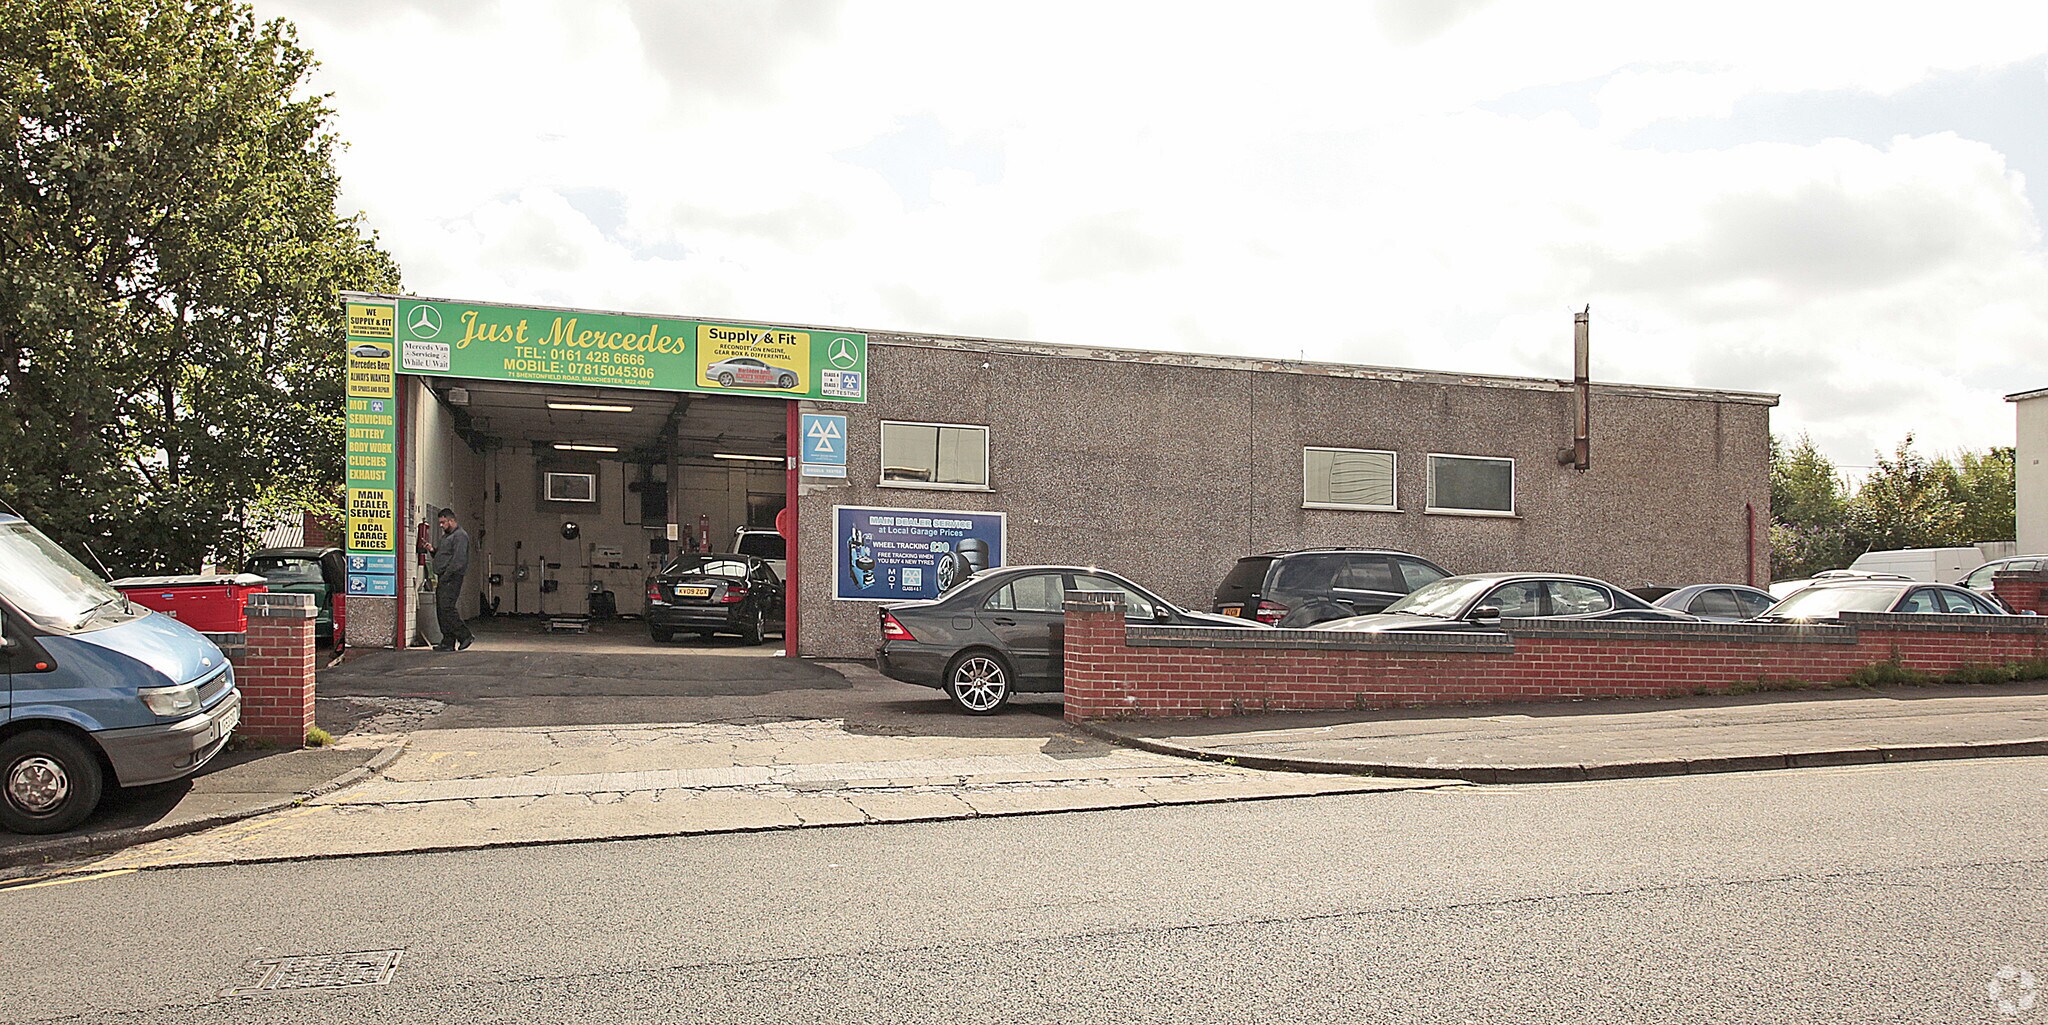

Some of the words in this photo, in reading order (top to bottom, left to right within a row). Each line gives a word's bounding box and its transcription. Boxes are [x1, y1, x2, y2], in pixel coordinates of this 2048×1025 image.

[366, 308, 376, 316] WE
[350, 316, 374, 326] SUPPLY
[382, 318, 392, 327] FIT
[456, 310, 529, 350] Just
[538, 316, 686, 355] Mercedes
[709, 328, 758, 344] Supply
[764, 333, 774, 344] &
[778, 334, 797, 345] Fit
[514, 346, 546, 360] TEL:
[550, 348, 581, 361] 0161
[586, 351, 610, 363] 428
[614, 353, 645, 366] 6666
[750, 352, 792, 360] DIFFERENTIAL
[350, 359, 377, 370] Mercedes
[378, 360, 390, 370] Benz
[404, 358, 424, 366] While
[504, 358, 564, 374] MOBILE:
[568, 362, 654, 379] 07815045306
[350, 372, 370, 382] ALWAYS
[370, 374, 390, 383] WANTED
[516, 372, 560, 380] SHENTONFIELD
[582, 376, 624, 384] MANCHESTER,
[350, 400, 368, 411] MOT
[350, 413, 392, 426] SERVICING
[350, 428, 384, 440] BATTERY
[350, 442, 368, 453] BODY
[370, 443, 392, 454] WORK
[350, 455, 386, 468] CLUCHES
[350, 469, 386, 481] EXHAUST
[358, 490, 384, 500] MAIN
[353, 500, 388, 509] DEALER
[350, 508, 391, 518] SERVICE
[358, 524, 384, 532] LOCAL
[870, 516, 894, 526] MAIN
[896, 518, 932, 528] DEALER
[932, 519, 972, 530] SERVICE
[354, 532, 387, 540] GARAGE
[910, 528, 938, 536] Garage
[355, 540, 386, 548] PRICES
